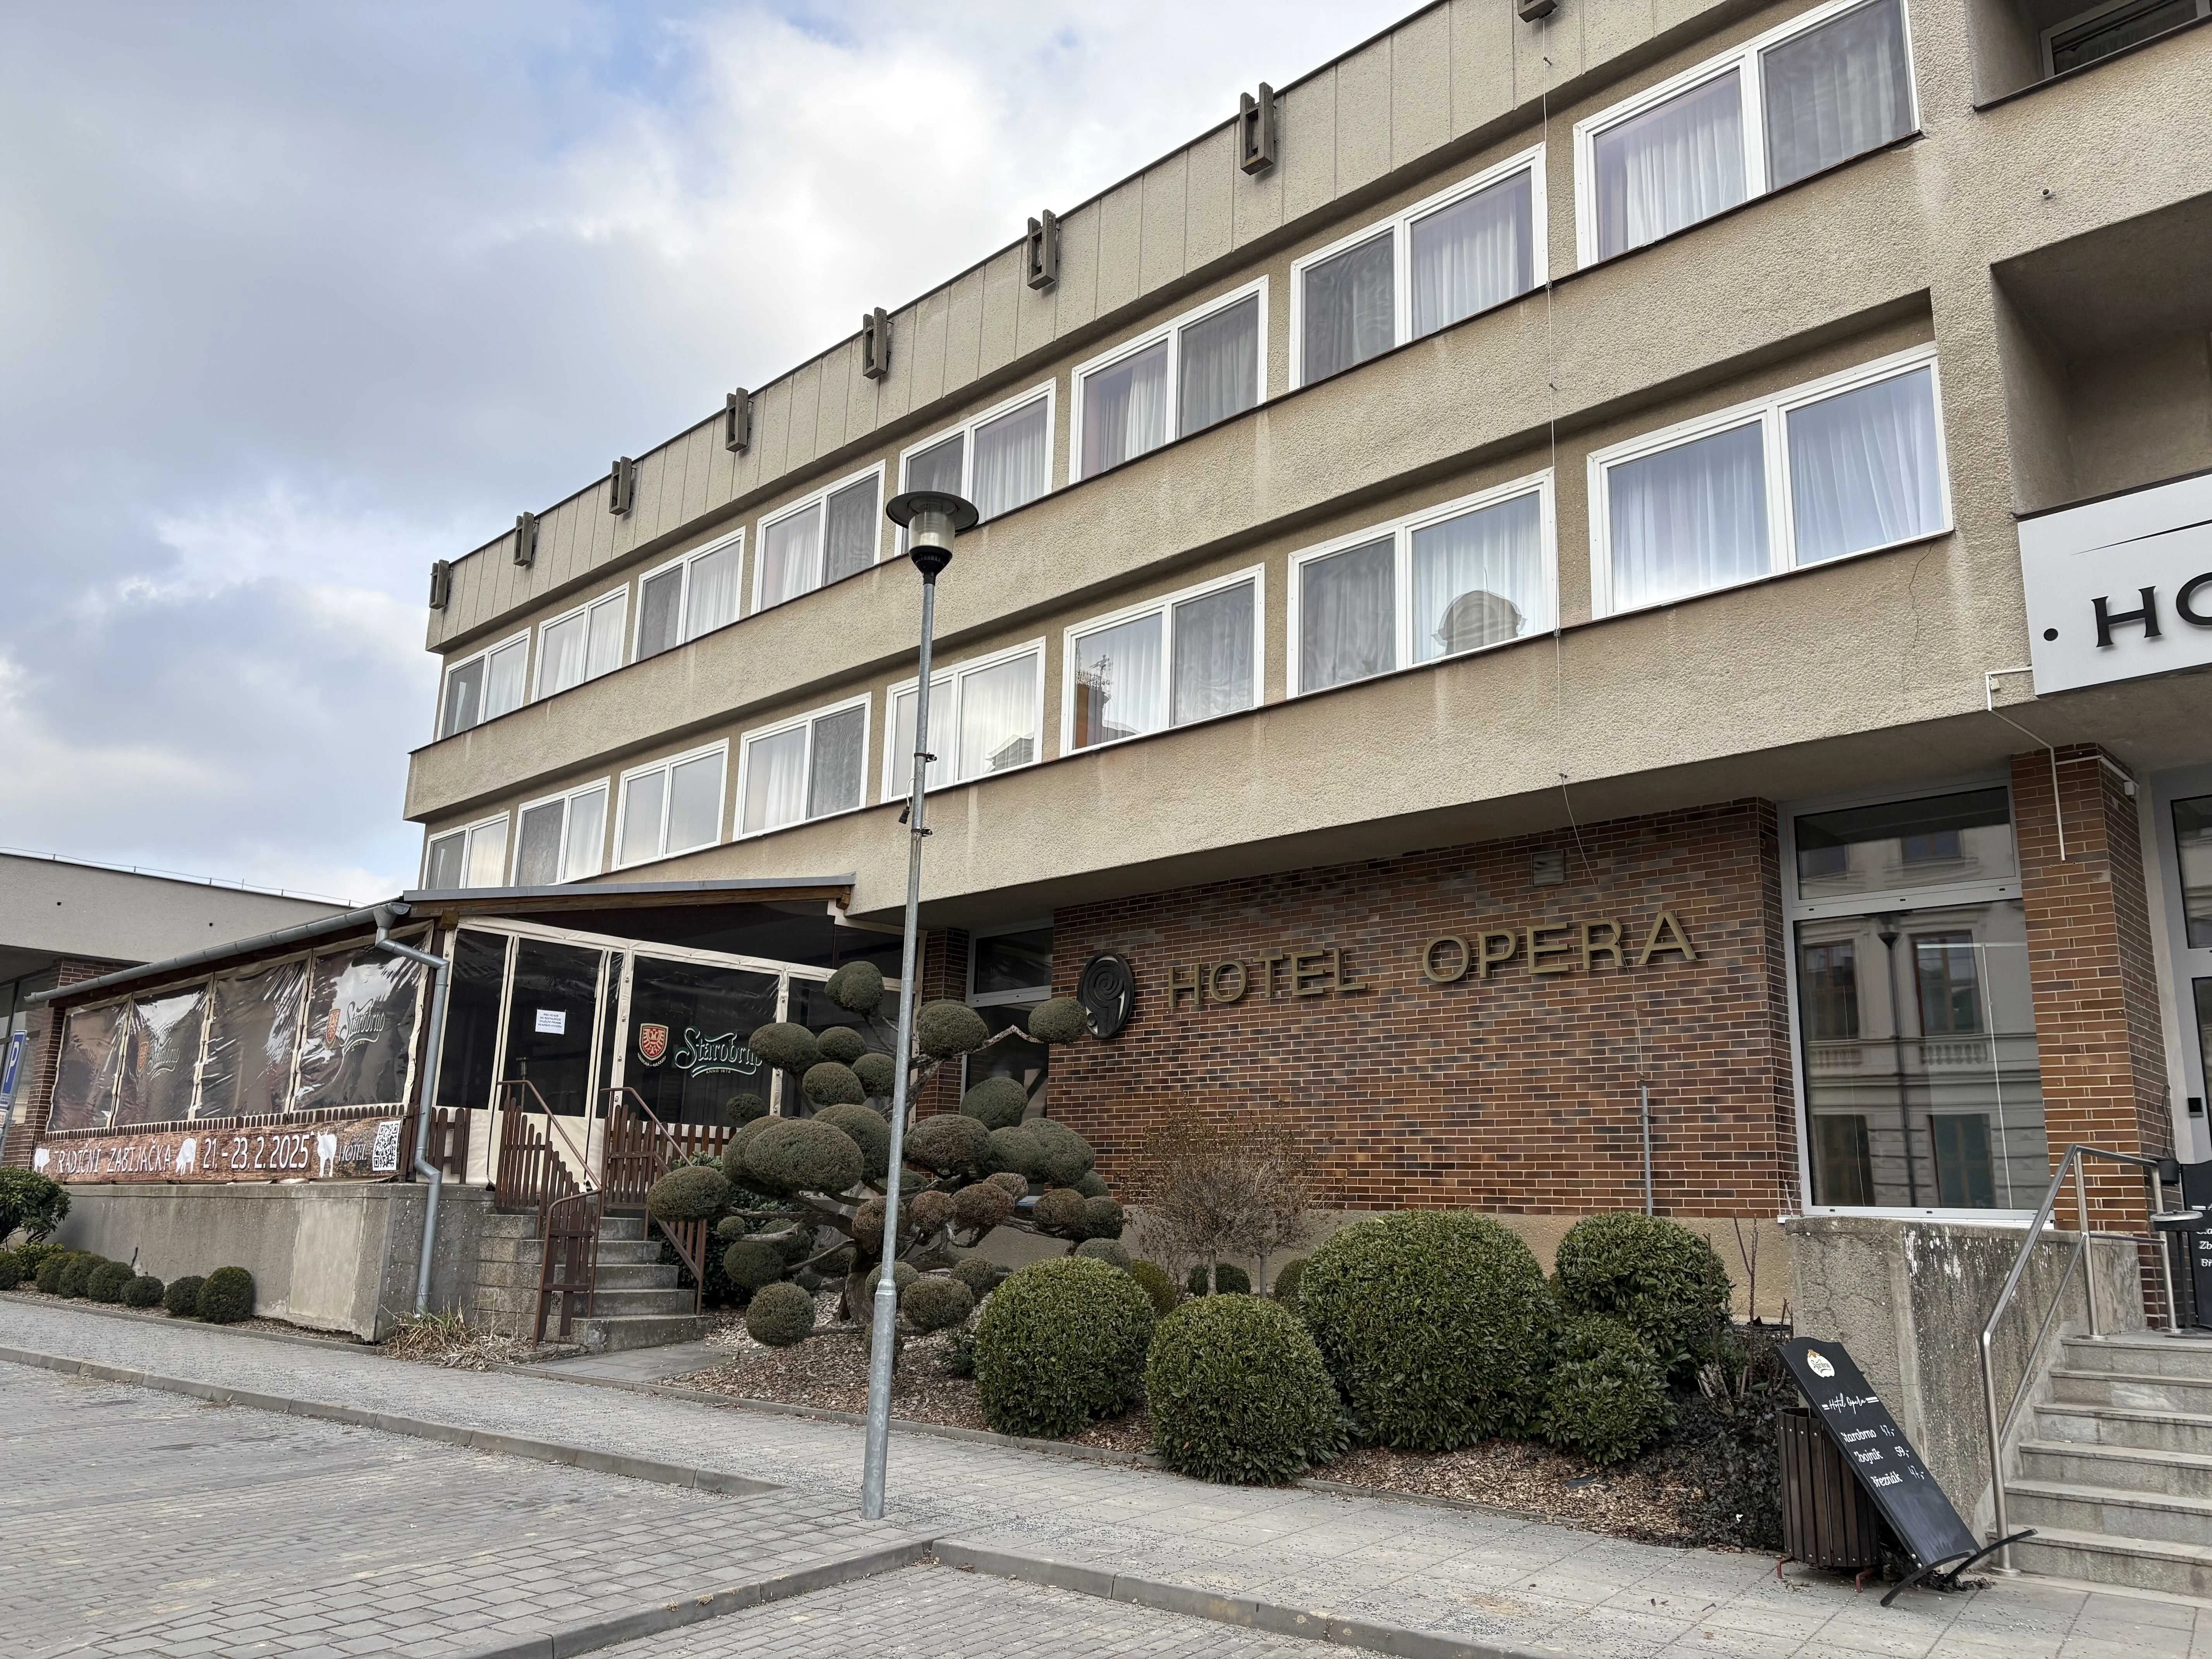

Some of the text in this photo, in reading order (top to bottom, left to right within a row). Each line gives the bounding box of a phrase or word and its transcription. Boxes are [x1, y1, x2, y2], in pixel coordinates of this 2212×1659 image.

[1168, 910, 1698, 1007] HOTEL OPERA
[6, 1041, 19, 1083] P
[106, 1137, 171, 1173] ZABIJAČKA
[203, 1137, 217, 1169] 21.
[270, 1134, 310, 1168] 2025
[338, 1144, 367, 1161] HOTEL
